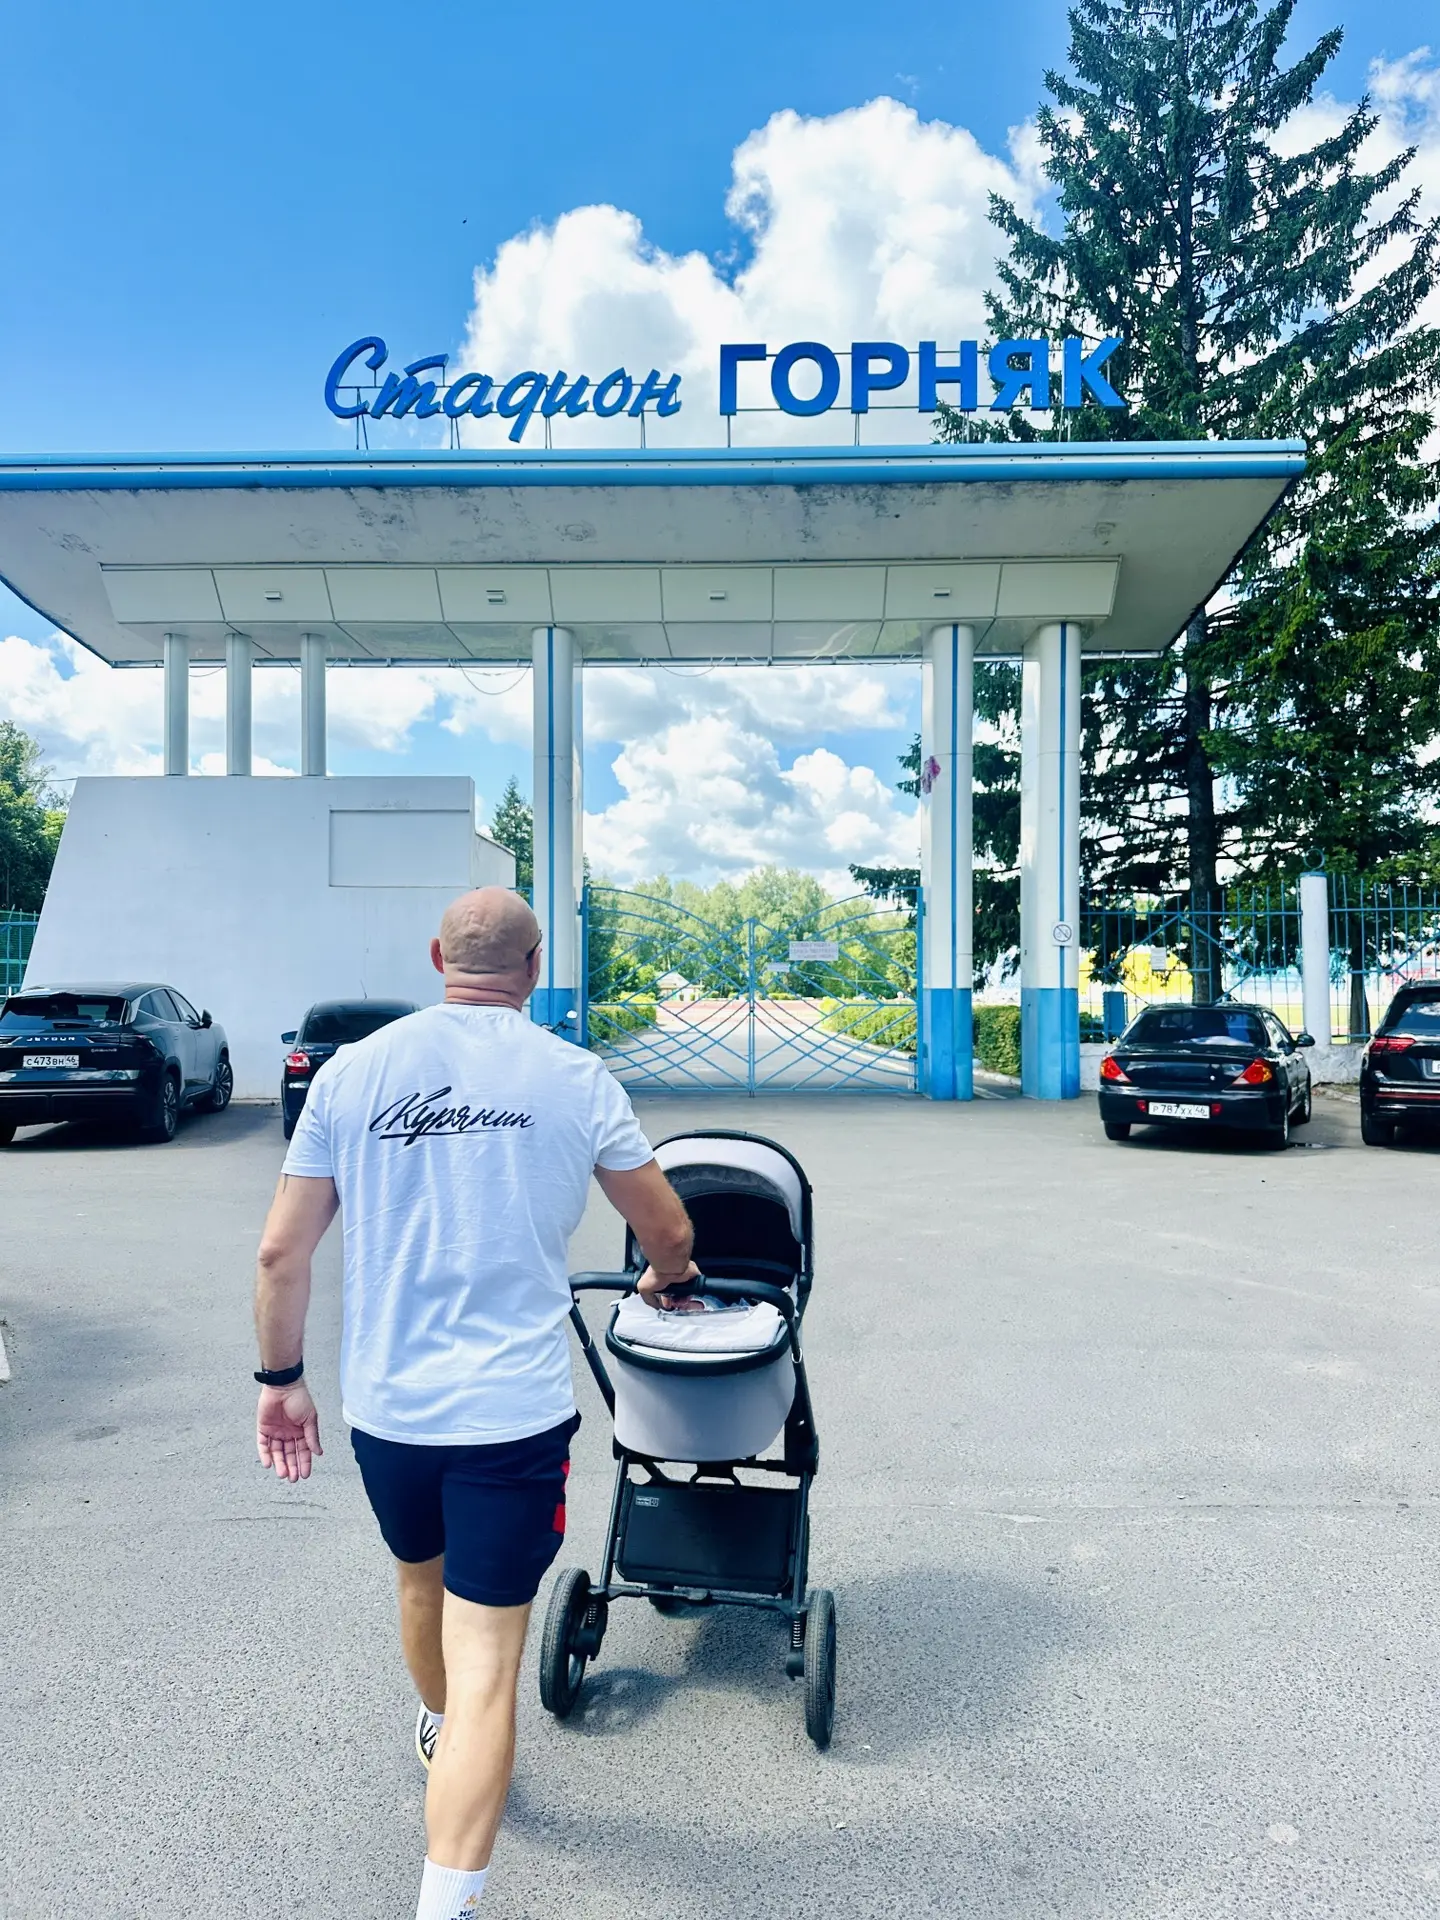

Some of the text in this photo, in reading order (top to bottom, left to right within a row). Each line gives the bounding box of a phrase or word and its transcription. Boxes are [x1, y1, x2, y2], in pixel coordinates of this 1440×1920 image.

[324, 336, 1126, 443] Стадион ГОРНЯК
[369, 1085, 536, 1146] Курянин
